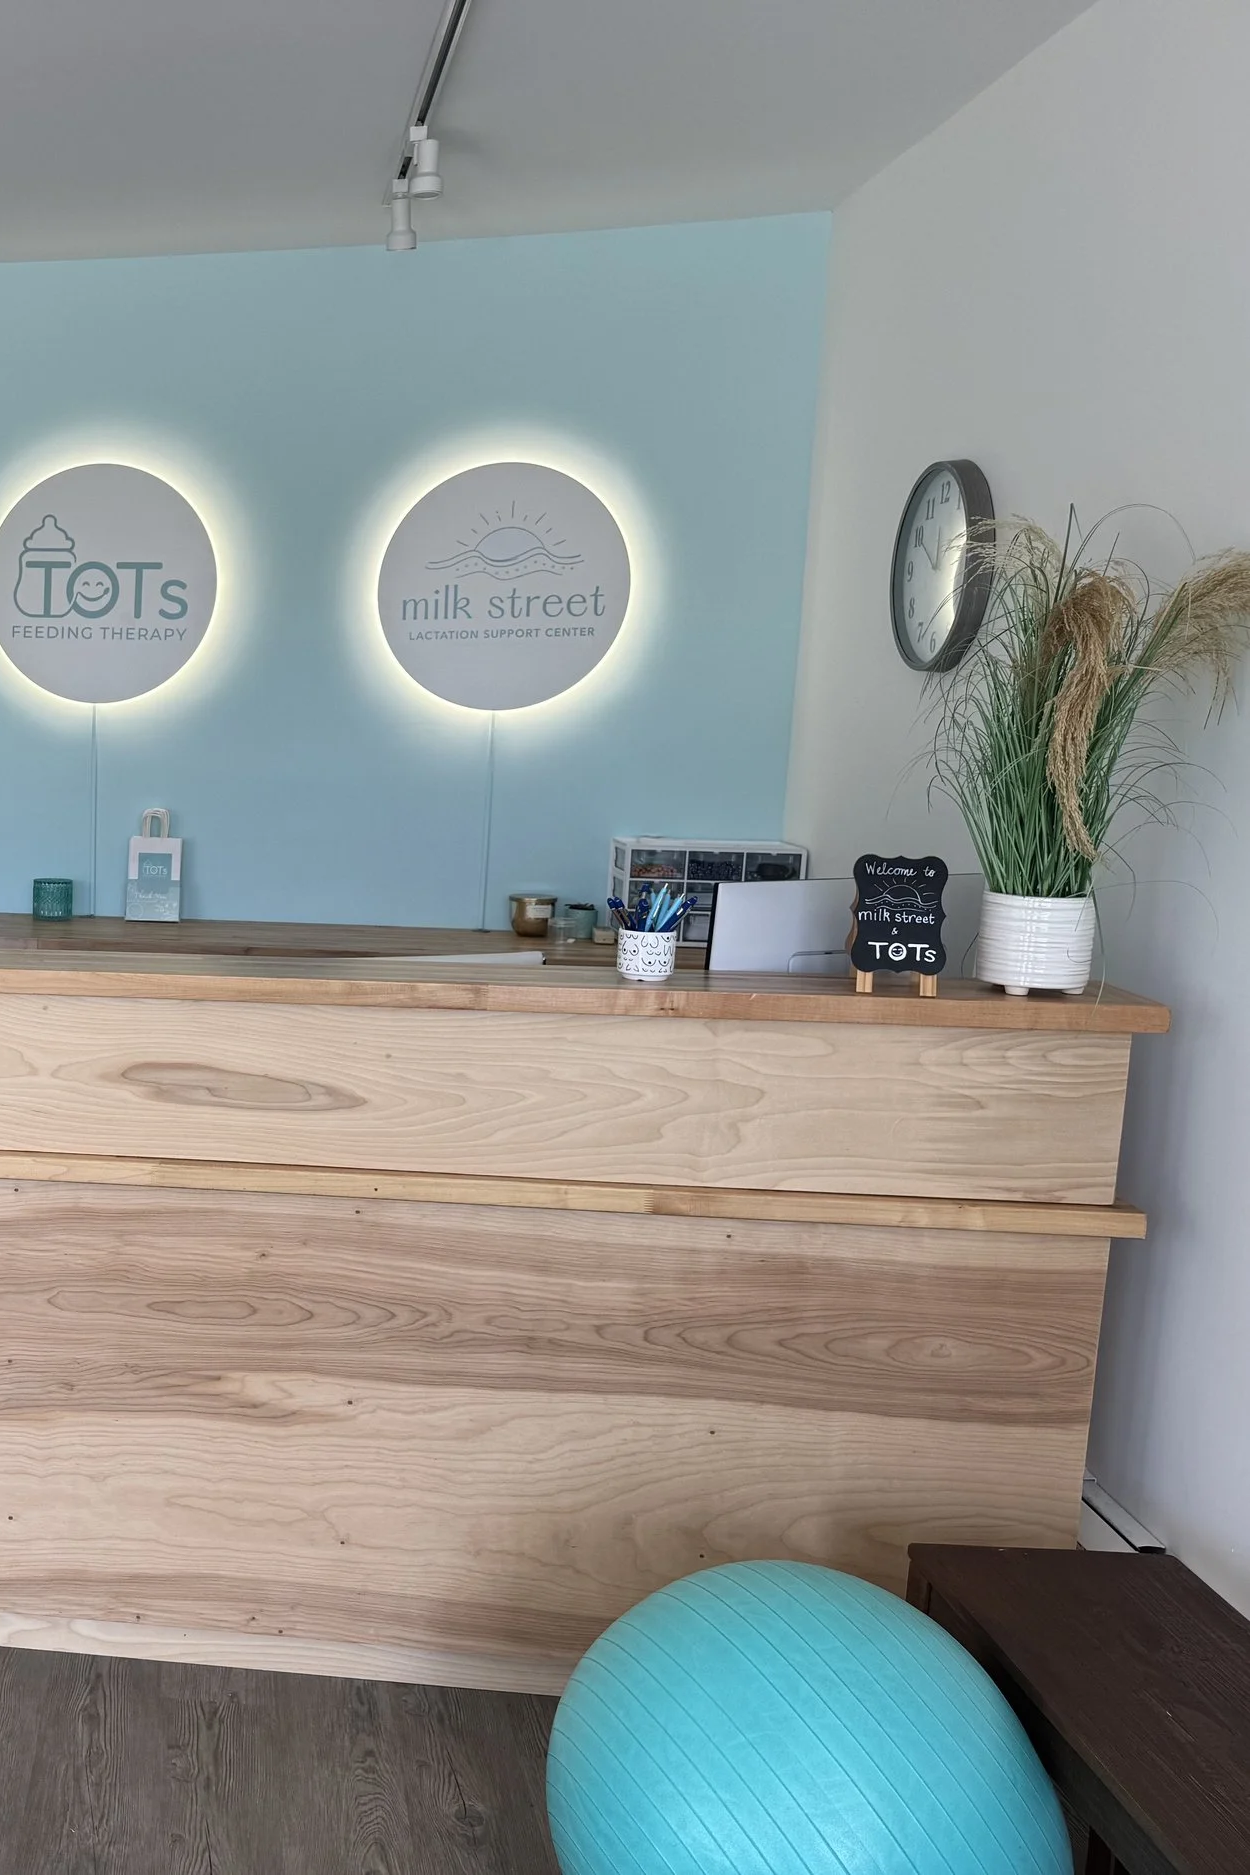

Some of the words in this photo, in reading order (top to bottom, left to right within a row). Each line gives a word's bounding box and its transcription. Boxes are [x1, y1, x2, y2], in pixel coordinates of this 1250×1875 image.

[939, 480, 951, 504] 12
[925, 497, 936, 521] 11
[914, 526, 924, 548] 10
[906, 561, 914, 582] 9
[26, 561, 188, 620] TOTs
[402, 584, 472, 621] milk
[487, 586, 606, 619] street
[908, 597, 915, 619] 8
[12, 625, 93, 640] FEEDING
[100, 627, 187, 641] THERAPY
[409, 630, 479, 641] LACTATION
[484, 628, 541, 639] SUPPORT
[545, 627, 595, 638] CENTER
[917, 623, 924, 643] 7
[929, 631, 936, 653] 6
[865, 862, 917, 875] Welcome
[924, 866, 936, 877] to
[858, 909, 890, 922] milk
[895, 912, 935, 925] street
[891, 927, 899, 935] &
[868, 941, 937, 962] TOTs
